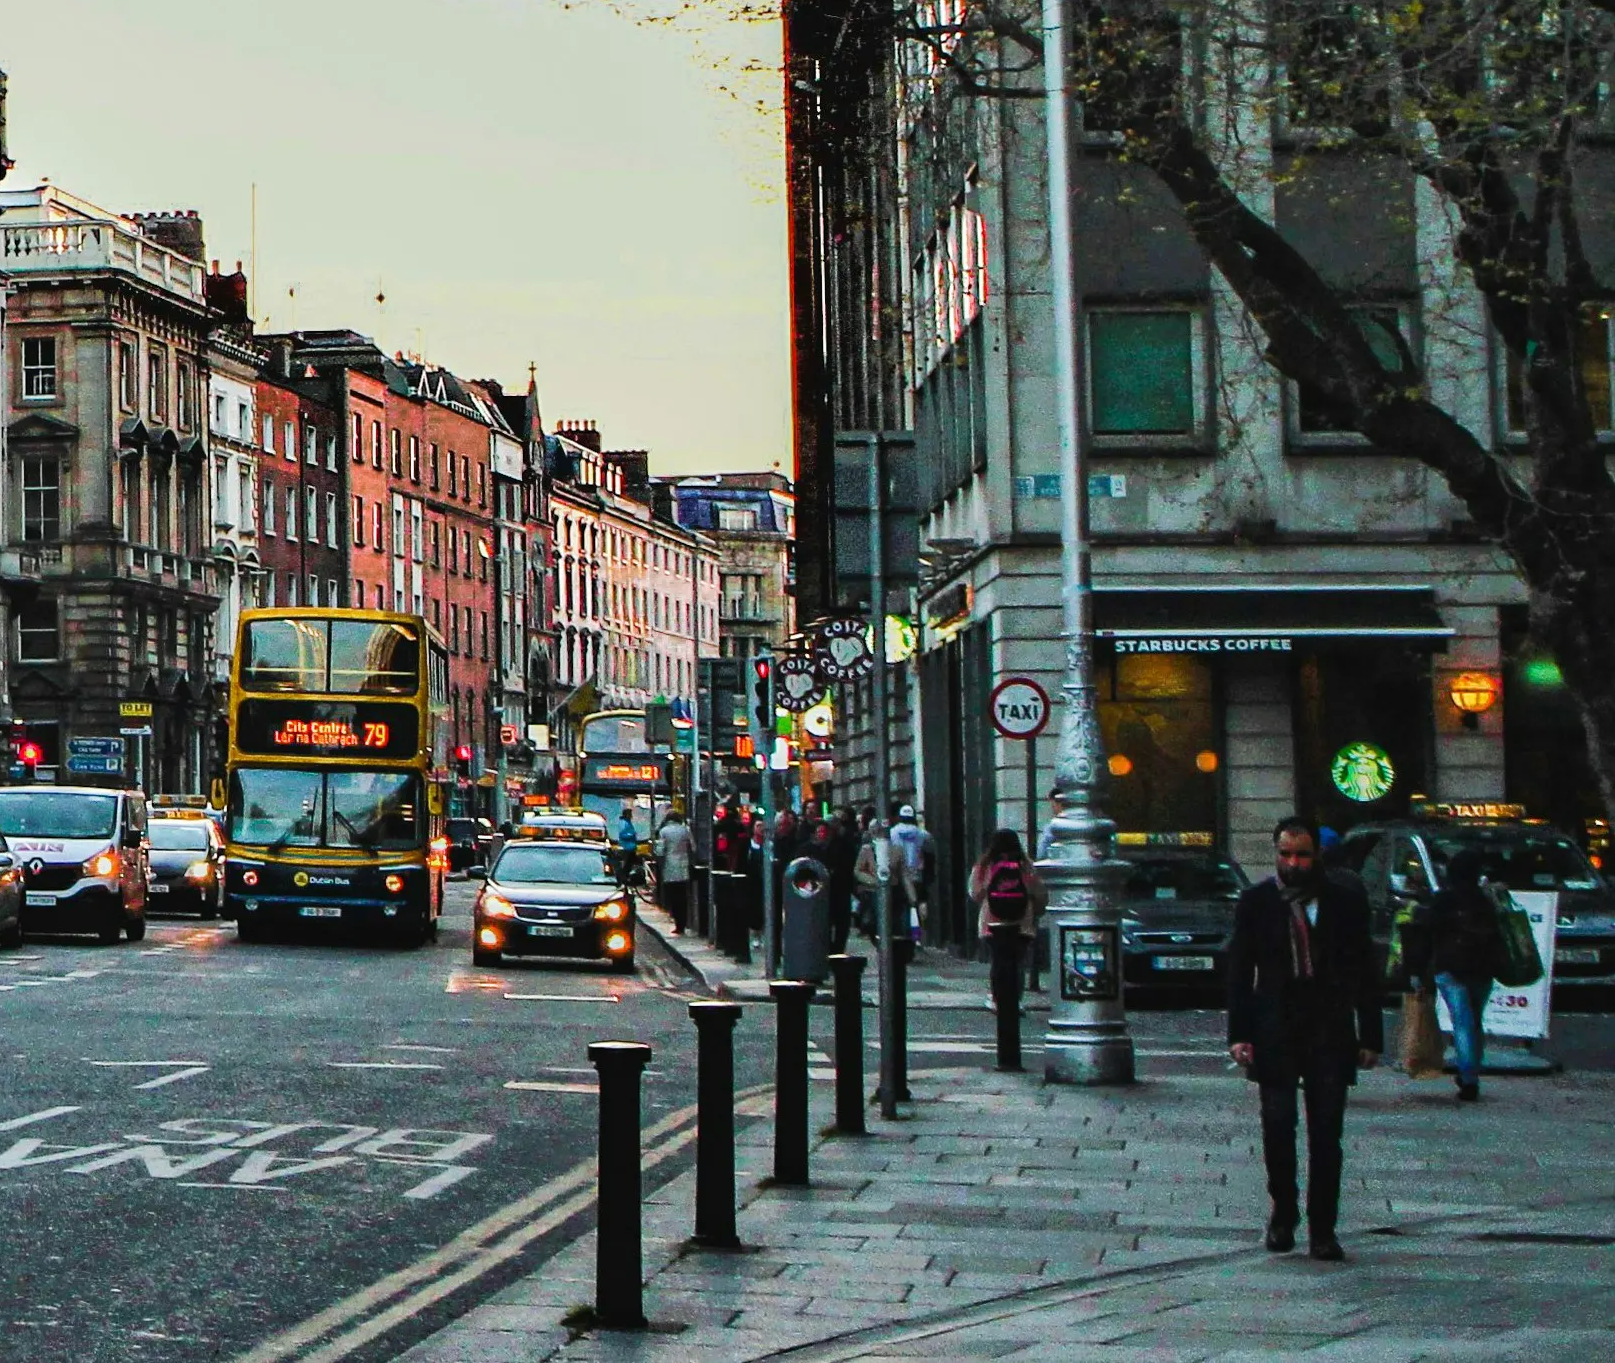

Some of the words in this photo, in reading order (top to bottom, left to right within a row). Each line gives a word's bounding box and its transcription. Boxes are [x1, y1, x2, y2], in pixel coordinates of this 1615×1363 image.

[825, 621, 867, 637] COSTA
[1114, 639, 1221, 653] STARBUCKS
[1224, 639, 1292, 651] COFFEE
[780, 660, 816, 675] COSTA
[820, 658, 873, 679] COFFEE
[121, 704, 132, 712] TO
[135, 704, 150, 712] LET
[777, 691, 822, 710] COFFEE
[998, 704, 1038, 719] TAXI
[364, 723, 386, 746] 79
[335, 877, 350, 885] Bus
[123, 1118, 494, 1160] BUS
